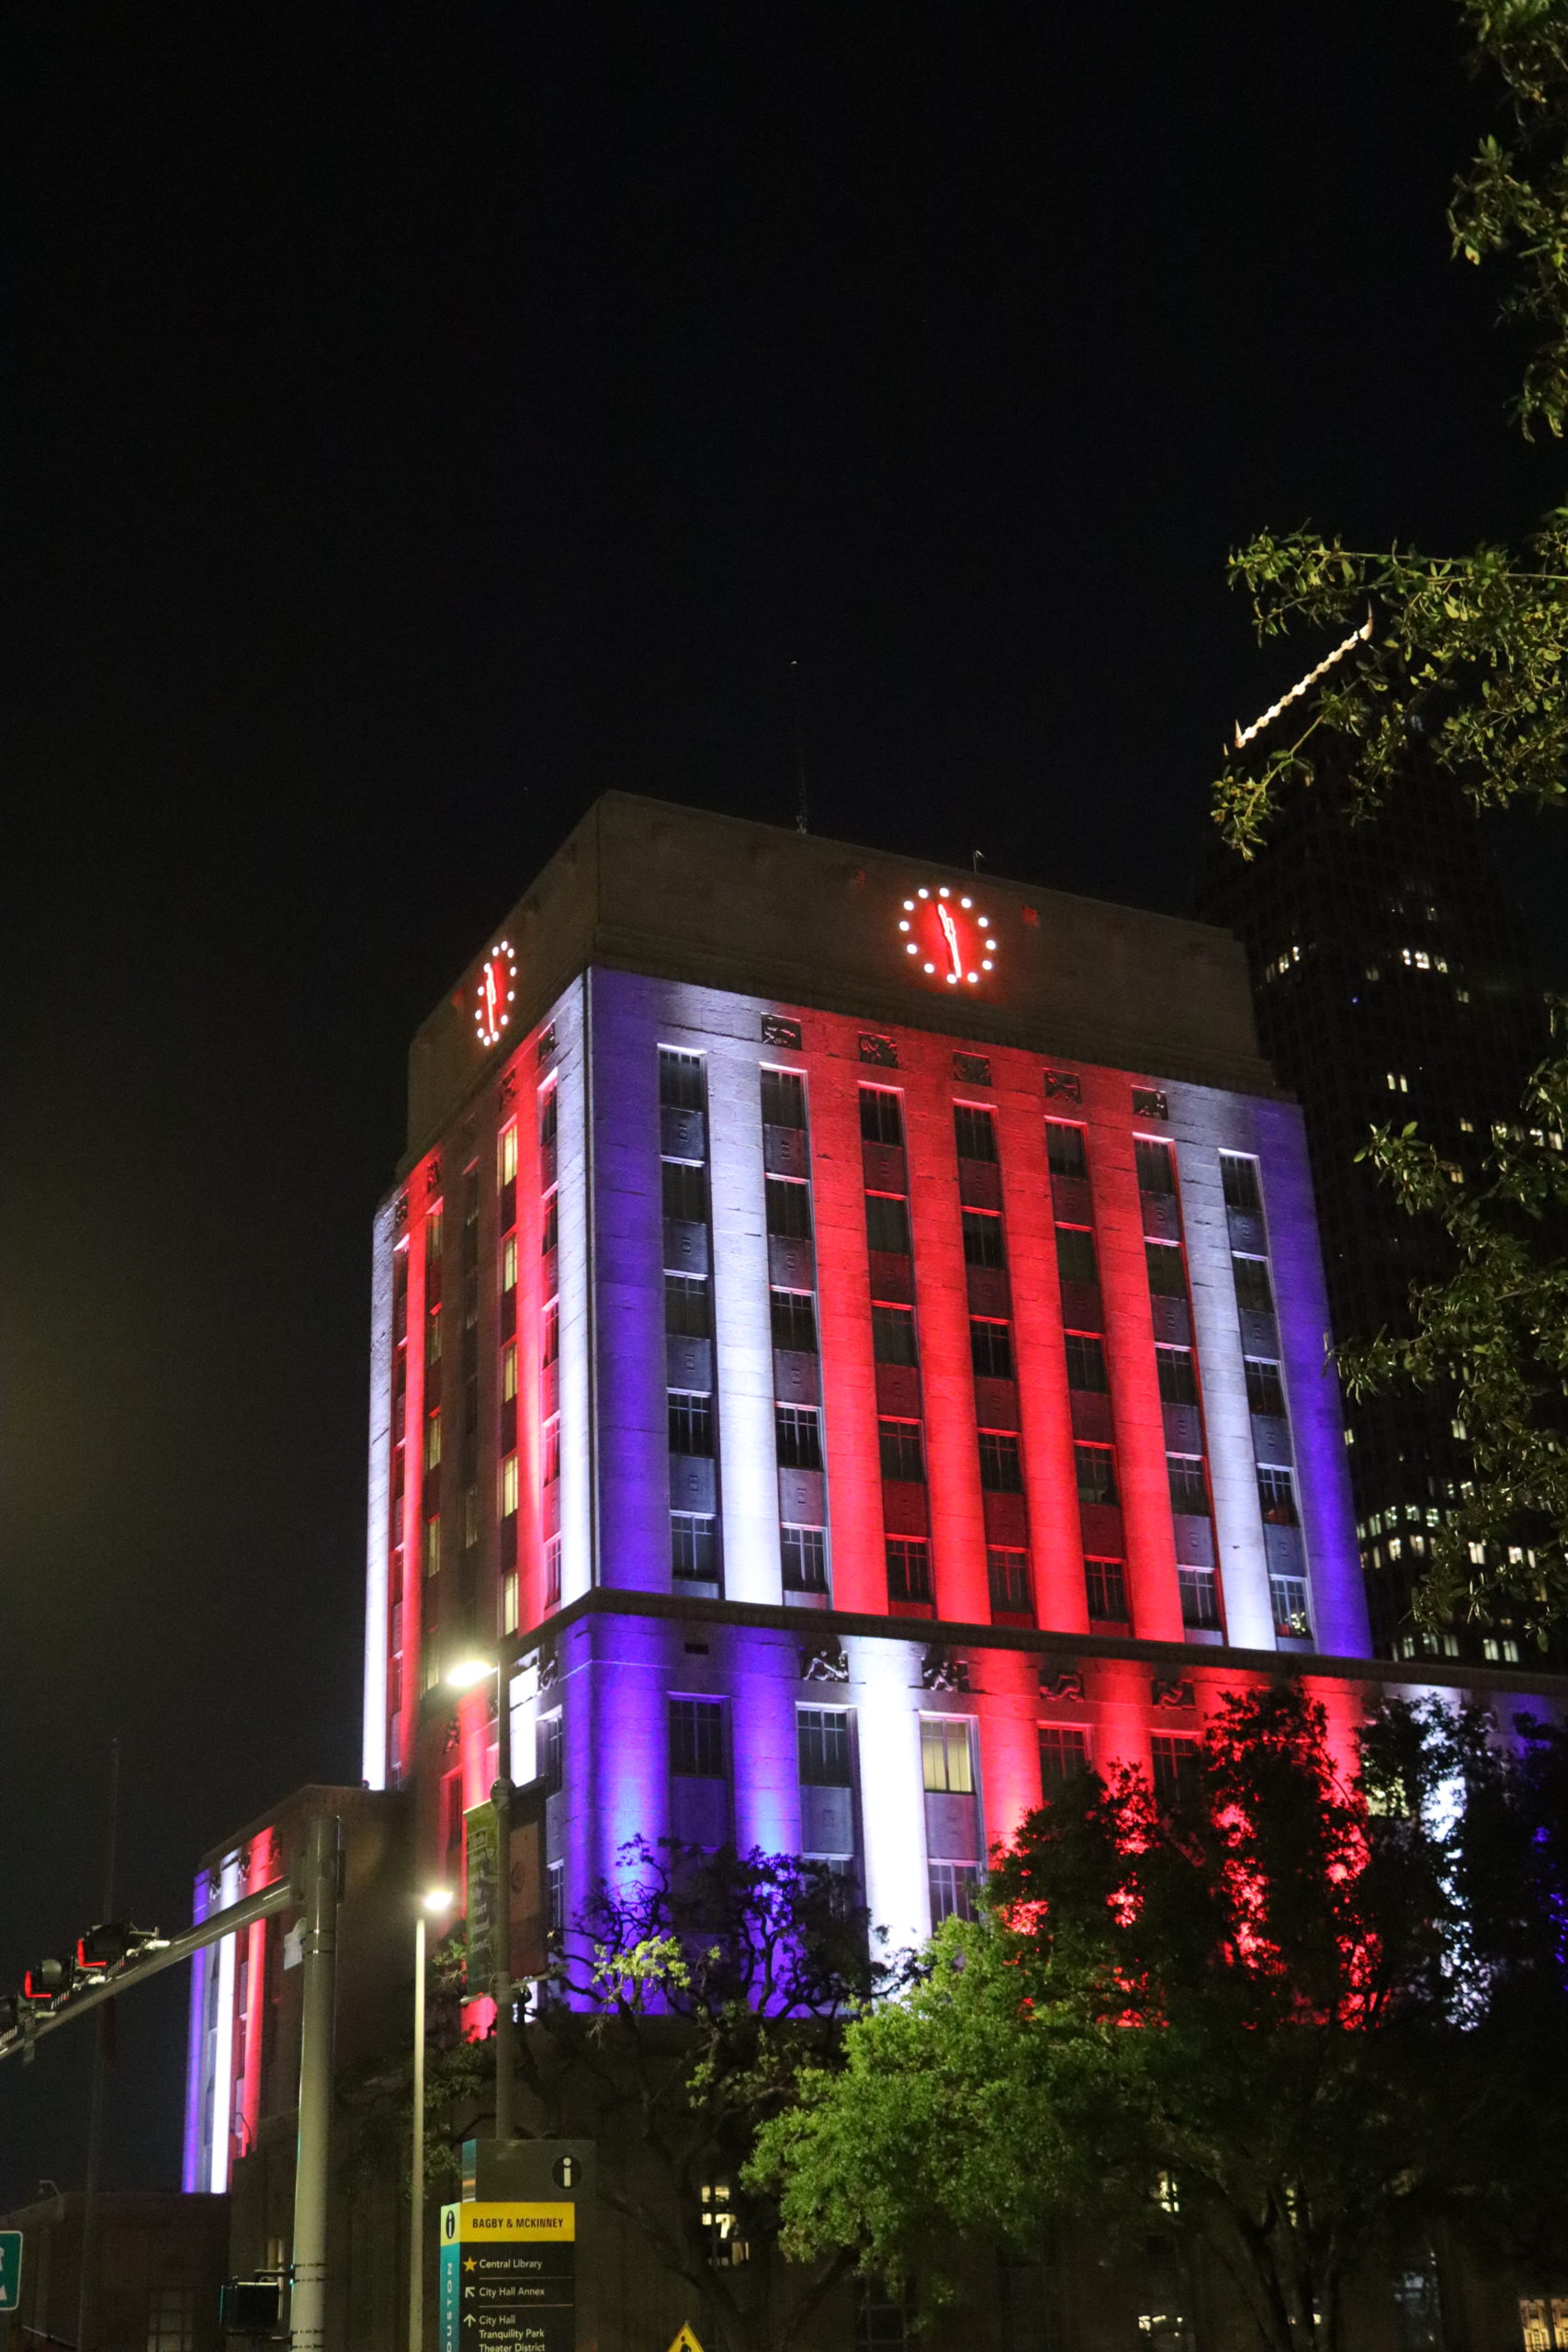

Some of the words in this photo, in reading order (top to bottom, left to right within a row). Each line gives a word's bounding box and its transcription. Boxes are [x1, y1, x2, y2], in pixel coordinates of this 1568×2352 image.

[472, 2218, 503, 2229] BAGBY
[506, 2218, 513, 2229] &
[515, 2218, 563, 2228] MCKINNEY
[479, 2259, 511, 2269] Central
[513, 2259, 543, 2270] Library
[479, 2287, 497, 2299] City
[499, 2287, 515, 2296] Hall
[517, 2287, 546, 2296] Annex
[479, 2315, 497, 2327] City
[499, 2315, 516, 2324] Hall
[479, 2329, 524, 2340] Tranquility
[525, 2328, 545, 2338] Park
[479, 2343, 513, 2352] Theater
[514, 2342, 546, 2352] District
